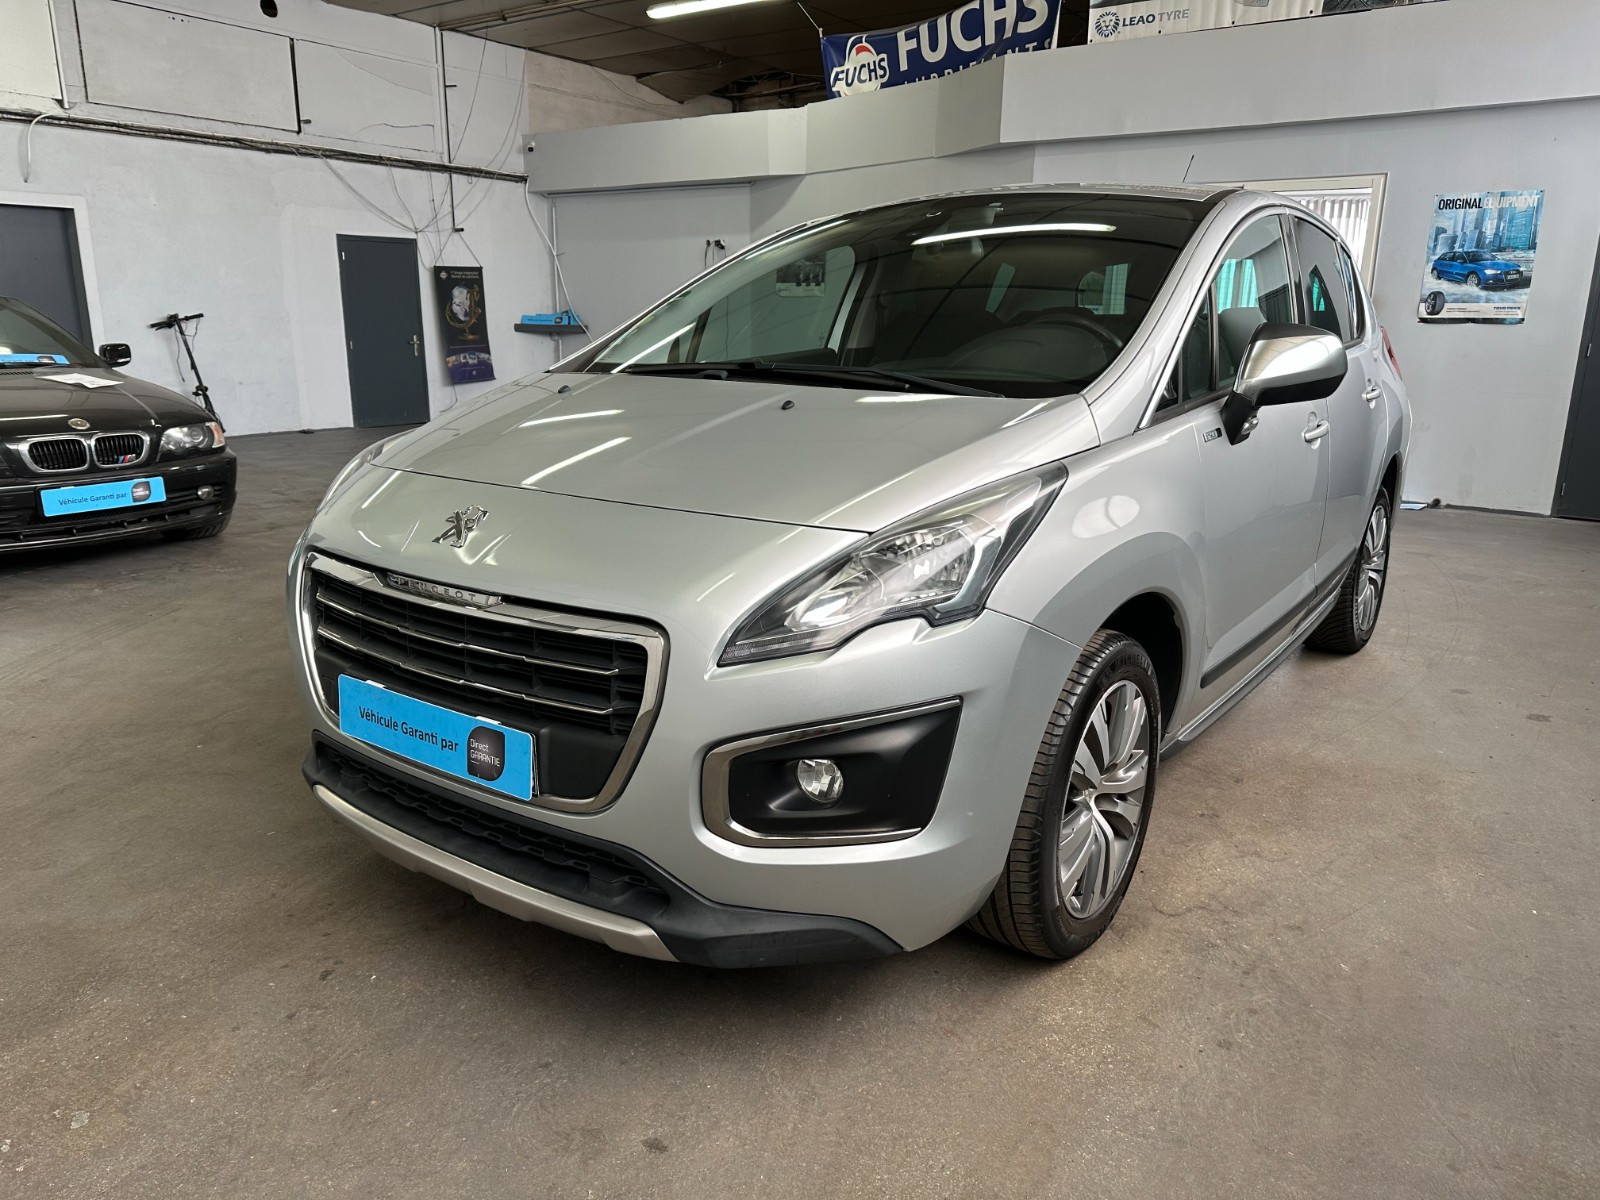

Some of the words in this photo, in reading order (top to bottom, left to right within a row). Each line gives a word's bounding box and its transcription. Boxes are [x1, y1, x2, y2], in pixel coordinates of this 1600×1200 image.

[1122, 13, 1156, 28] LEAO
[1157, 8, 1190, 22] TYRE
[897, 0, 1049, 72] FUCHS
[831, 57, 887, 88] FUCHS
[1438, 197, 1483, 210] ORIGINAL
[58, 496, 88, 506] Véhicule
[90, 494, 115, 503] Garanti
[116, 492, 127, 500] par
[397, 578, 476, 599] PEUGEOT
[358, 705, 399, 732] Véhicule
[401, 721, 438, 746] Garanti
[441, 737, 459, 752] par
[470, 738, 489, 751] Direct
[470, 750, 501, 767] GARANTIE
